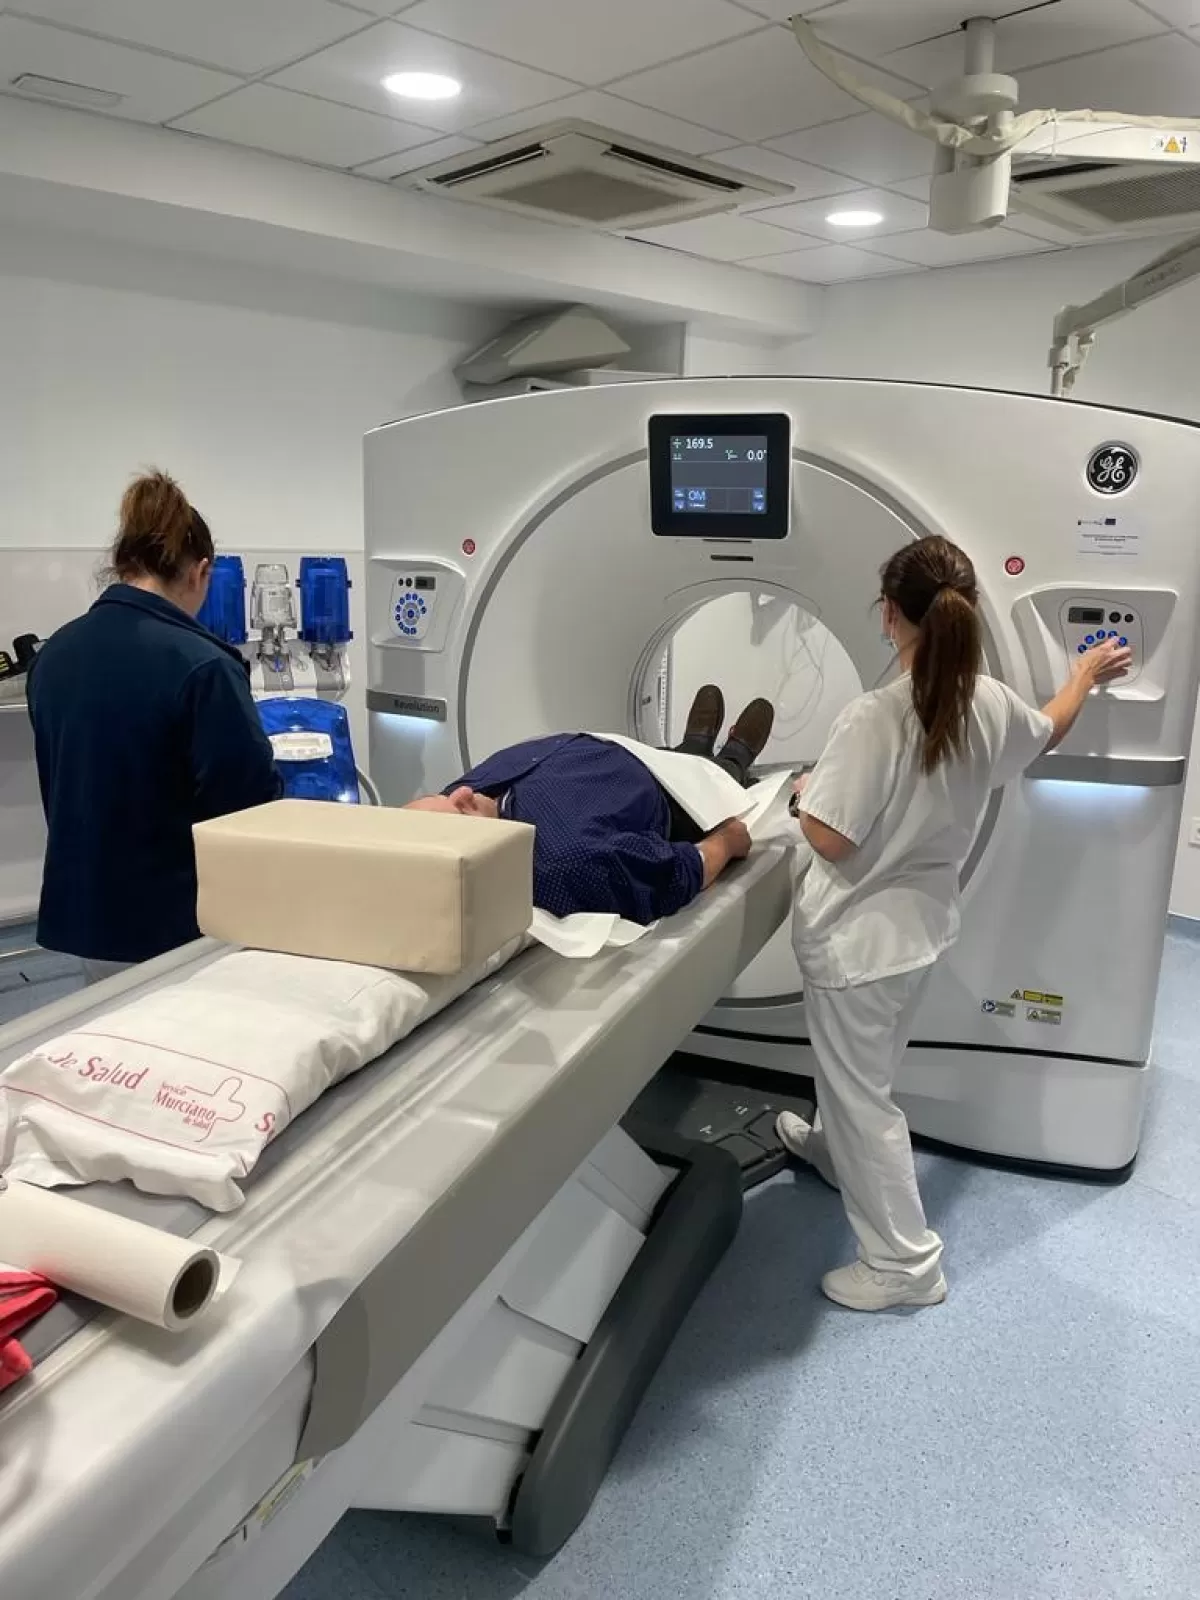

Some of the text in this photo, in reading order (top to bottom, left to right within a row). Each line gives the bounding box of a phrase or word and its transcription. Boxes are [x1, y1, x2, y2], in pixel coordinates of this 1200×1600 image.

[686, 438, 713, 449] 169.5
[79, 1056, 150, 1089] Salud
[155, 1090, 216, 1120] Murciano
